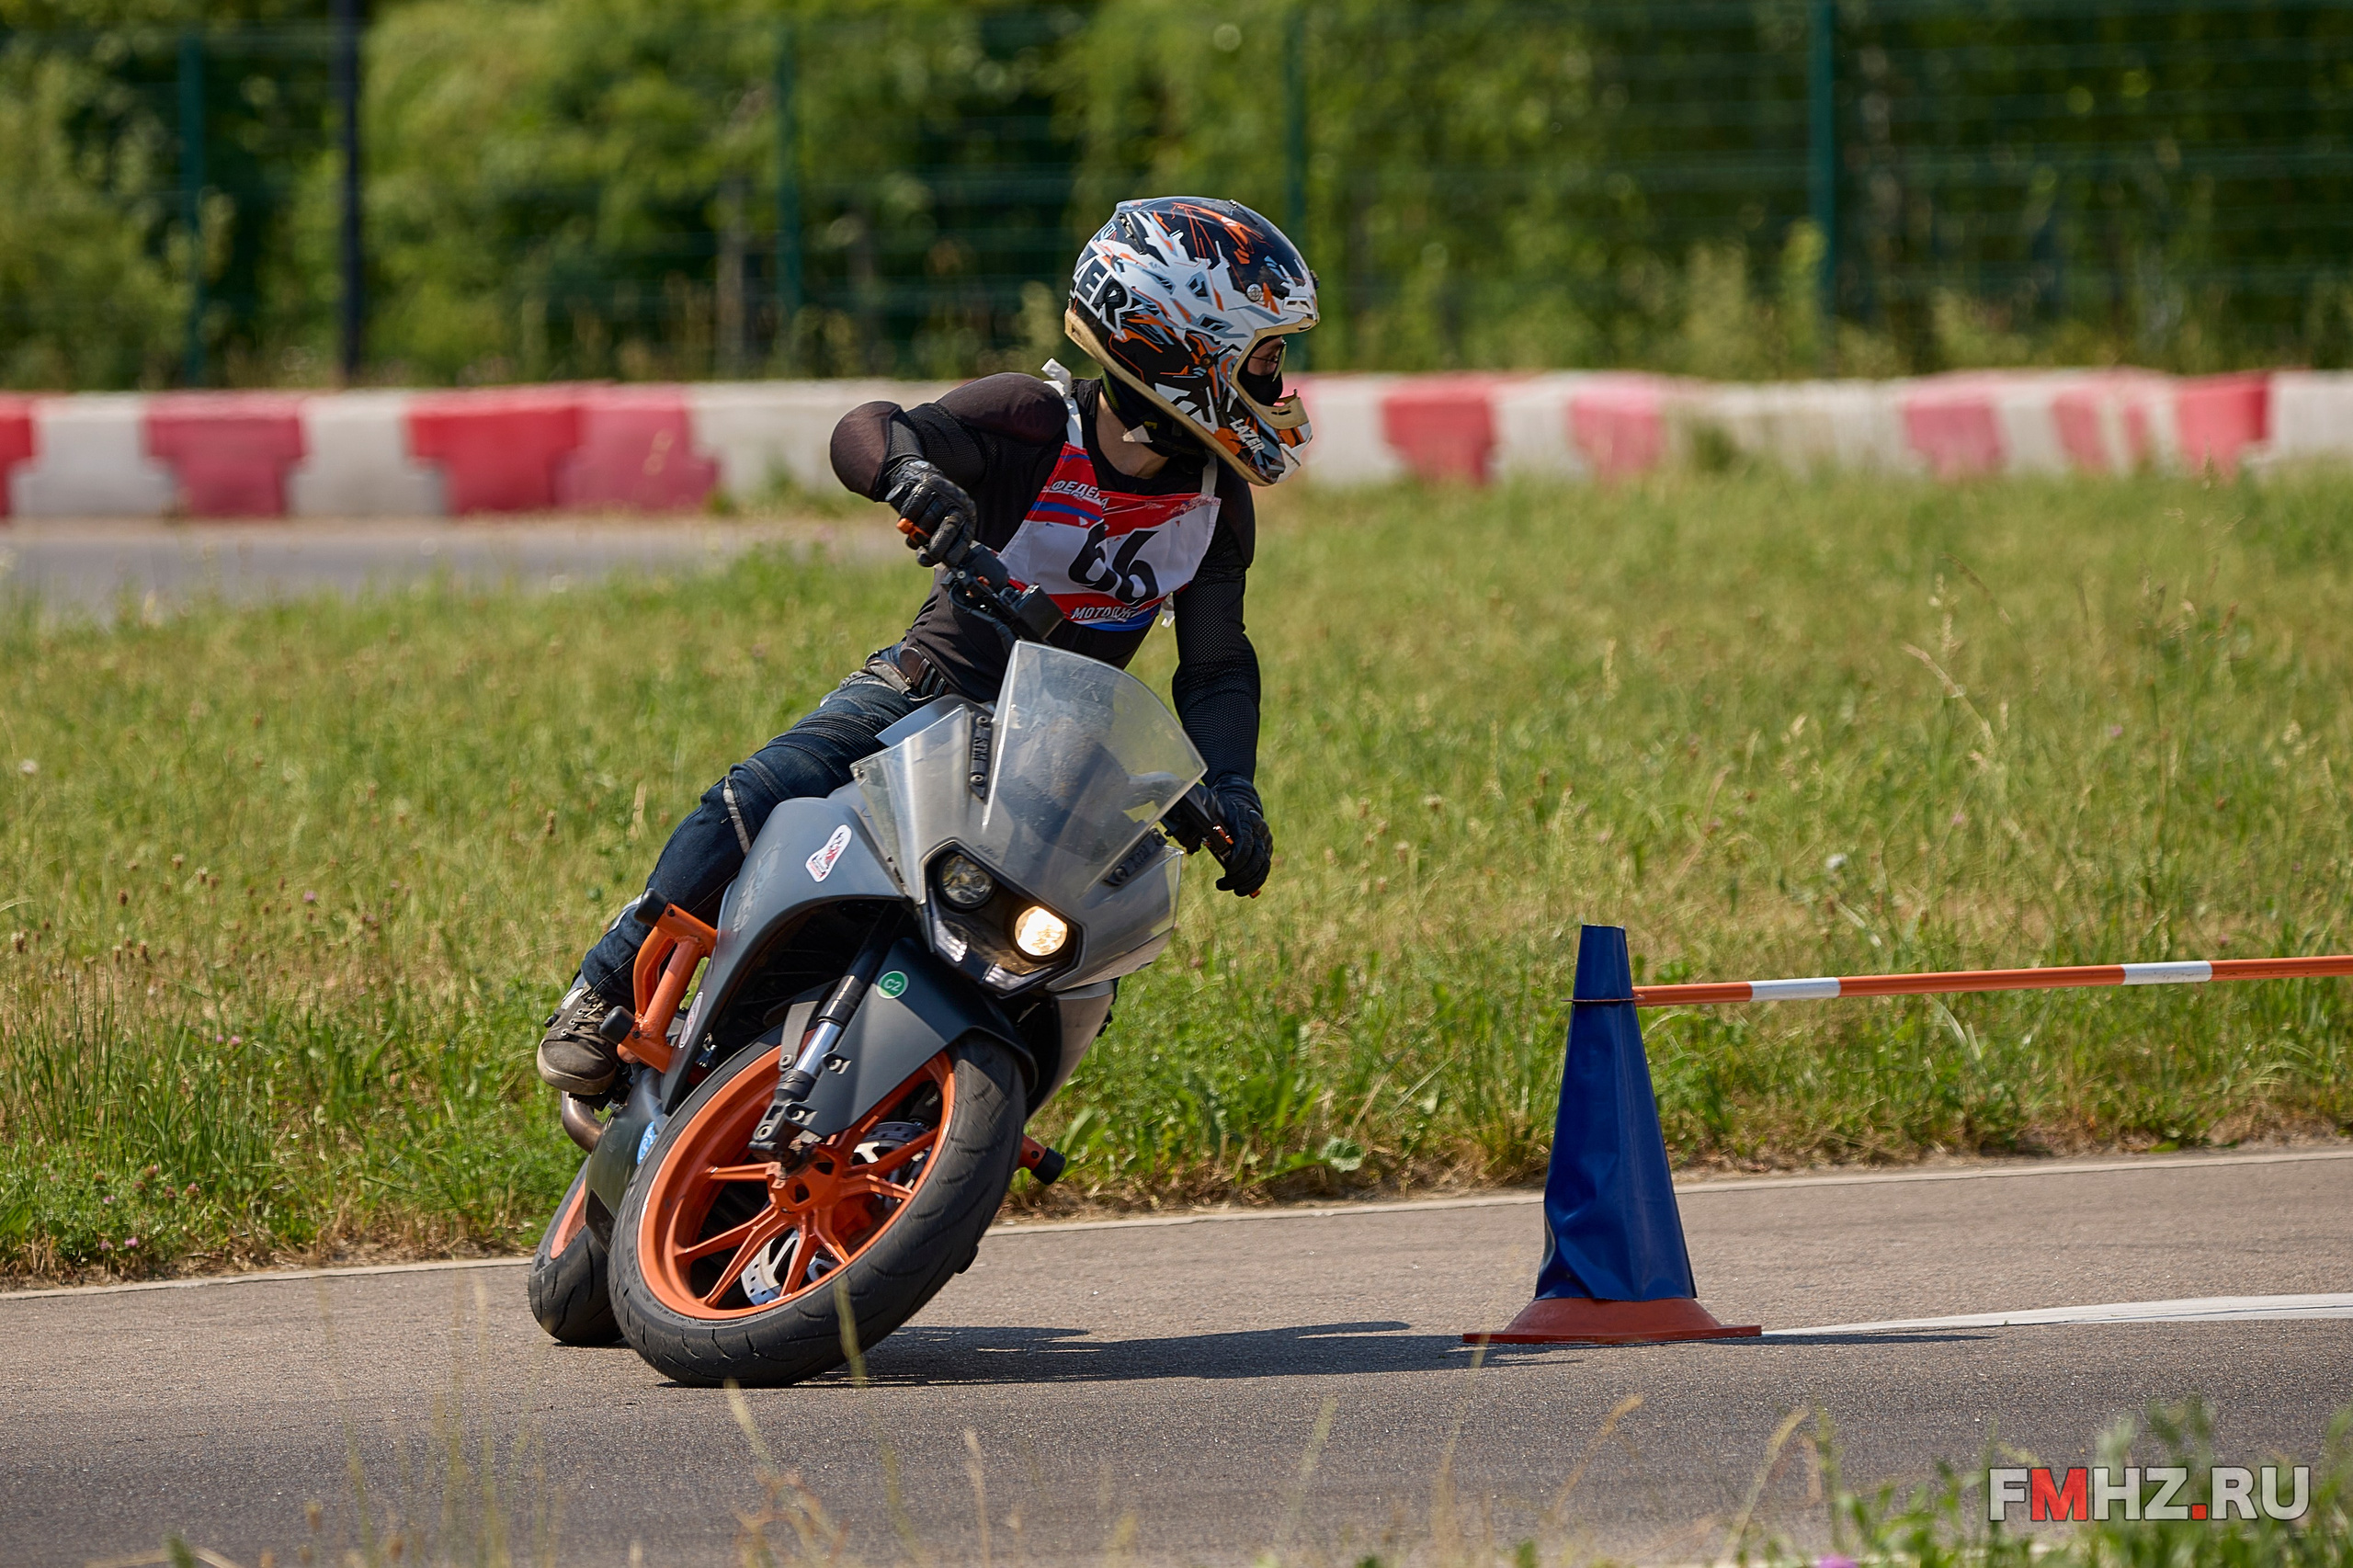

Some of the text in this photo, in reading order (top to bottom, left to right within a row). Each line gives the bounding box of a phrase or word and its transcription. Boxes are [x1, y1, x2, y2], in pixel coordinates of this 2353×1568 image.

[1229, 418, 1266, 454] LAZER
[1068, 519, 1160, 608] 66
[883, 979, 903, 992] C2
